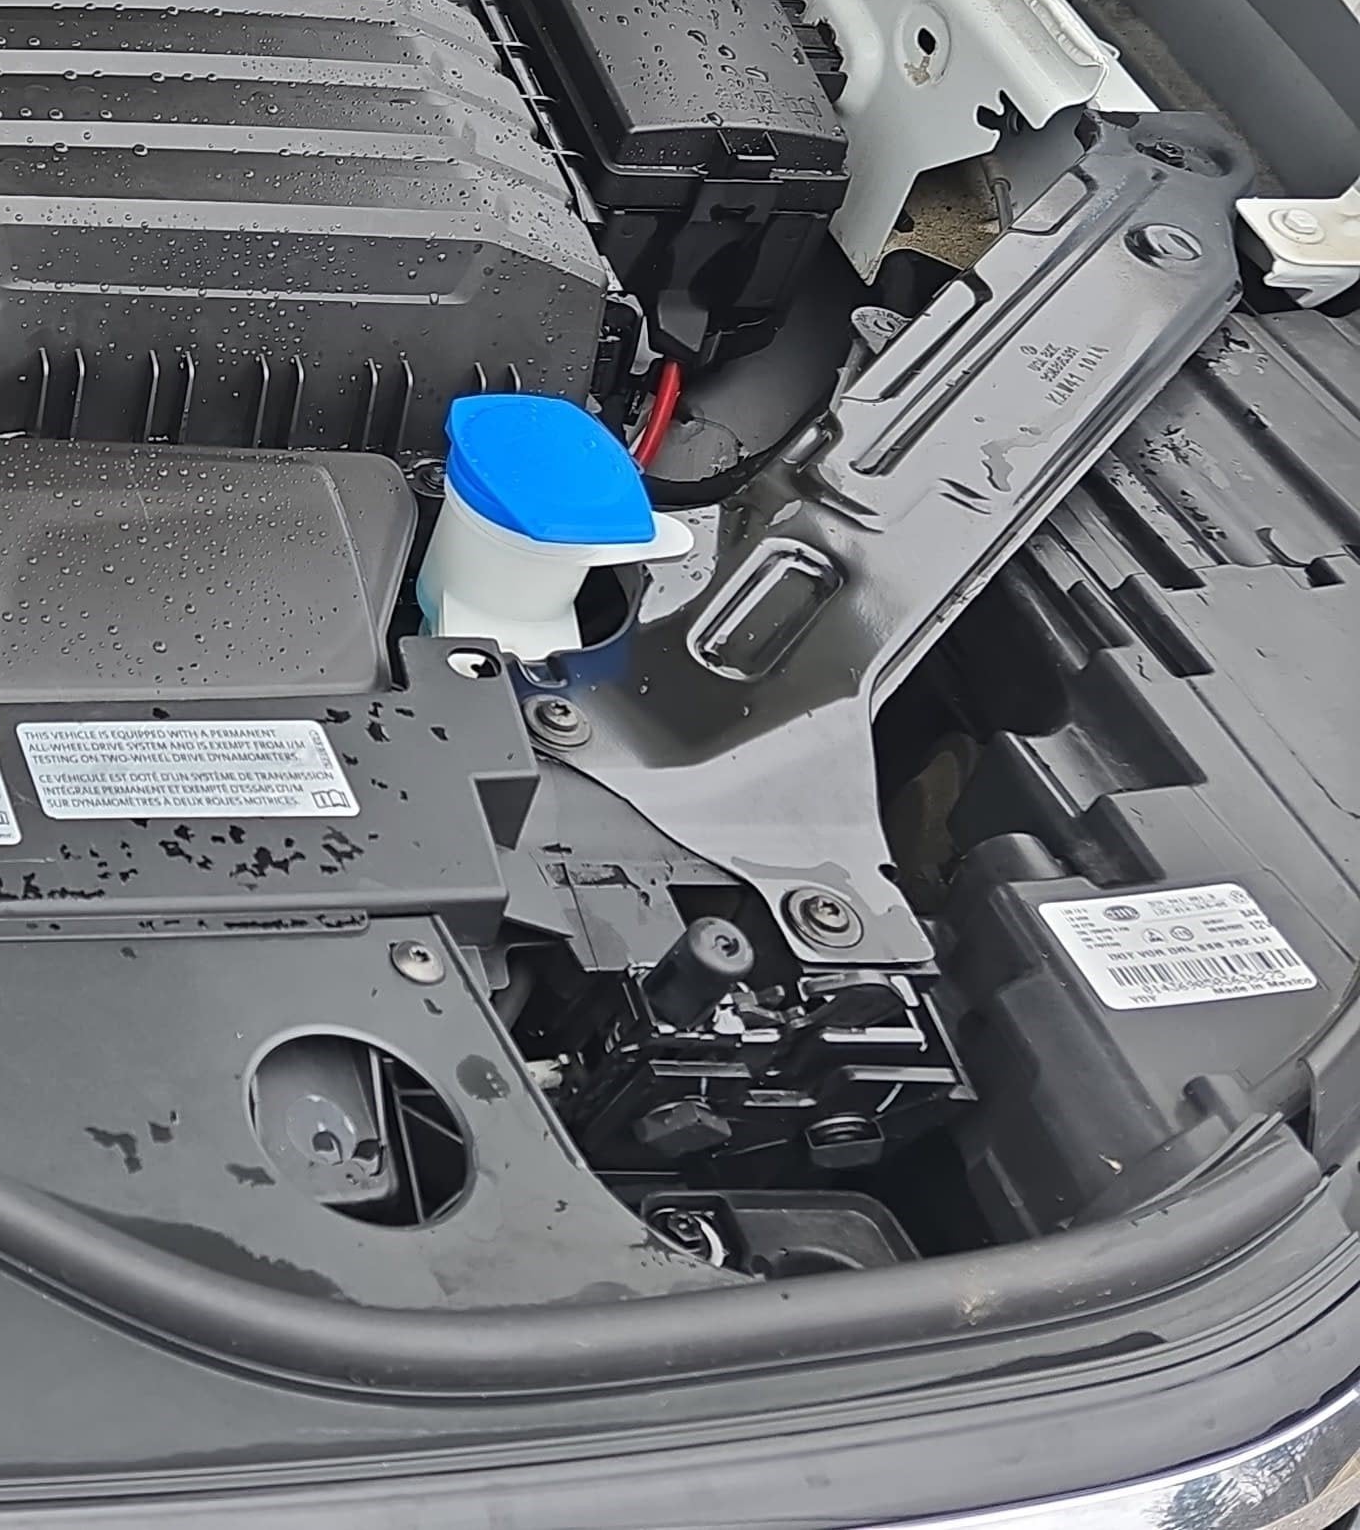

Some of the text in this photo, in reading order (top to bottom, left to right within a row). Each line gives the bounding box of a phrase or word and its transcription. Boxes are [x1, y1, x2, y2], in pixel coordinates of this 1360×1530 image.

[24, 728, 276, 741] THIS VEHICLE IS EQUIPPED WITH A PERMANENT
[29, 740, 305, 752] ALL-WHEEL DRIVE SYSTEM AND IS EXEMPT FROM I/M
[32, 754, 78, 764] TESTING
[80, 754, 99, 763] ON
[100, 753, 171, 763] TWO-WHEEL
[172, 752, 207, 762] DRIVE
[38, 774, 53, 783] CE
[108, 773, 128, 782] EST
[129, 772, 160, 782] DOTÉ
[190, 770, 238, 782] SYSTÈME
[238, 772, 254, 781] DE
[255, 771, 334, 781] TRANSMISSION
[43, 785, 100, 796] INTÉGRALE
[101, 785, 167, 795] PERMANENT
[167, 784, 181, 794] ET
[182, 783, 228, 794] EXEMPTÉ
[230, 784, 274, 793] D'ESSAIS
[46, 798, 69, 808] SUR
[71, 797, 162, 808] DYNAMOMÈTRES
[163, 795, 172, 806] À
[173, 796, 204, 806] DEUX
[205, 796, 243, 806] ROUES
[1212, 976, 1313, 995] Made in Mexico
